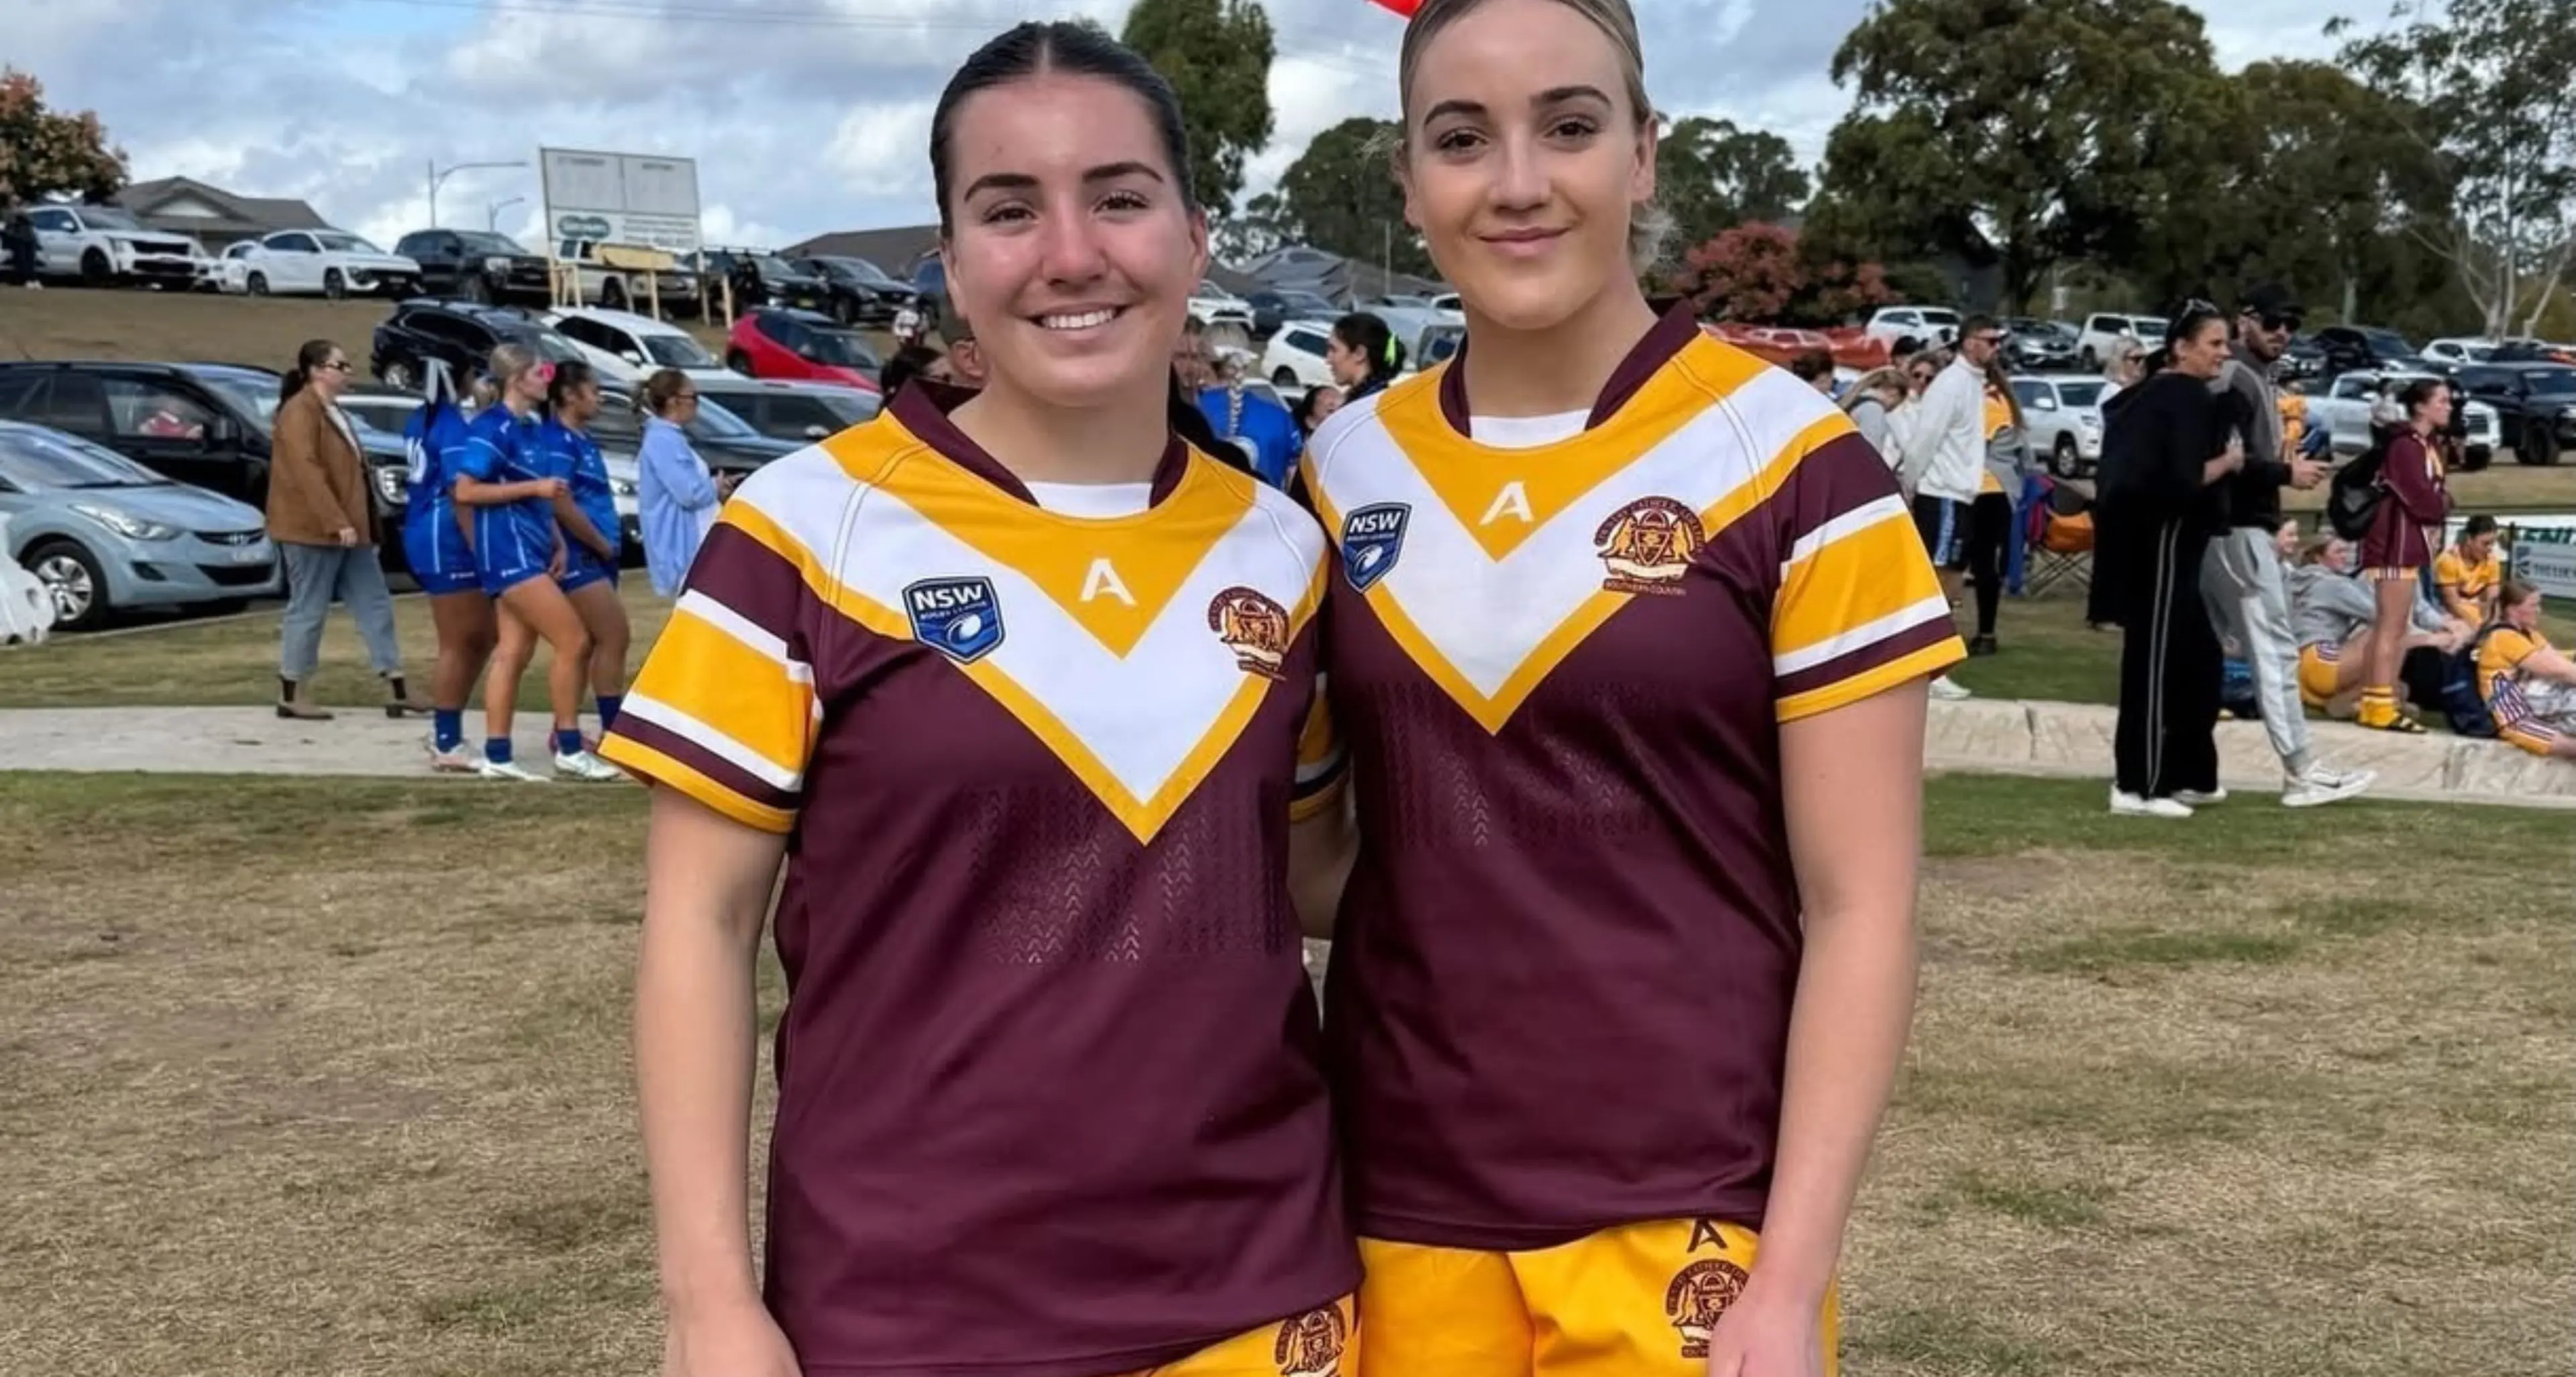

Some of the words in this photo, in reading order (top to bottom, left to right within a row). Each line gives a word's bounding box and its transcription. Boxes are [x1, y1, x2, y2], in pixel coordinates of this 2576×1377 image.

[1479, 480, 1535, 526] A
[1349, 511, 1401, 533] NSW
[913, 584, 983, 611] NSW
[1079, 557, 1138, 605] A
